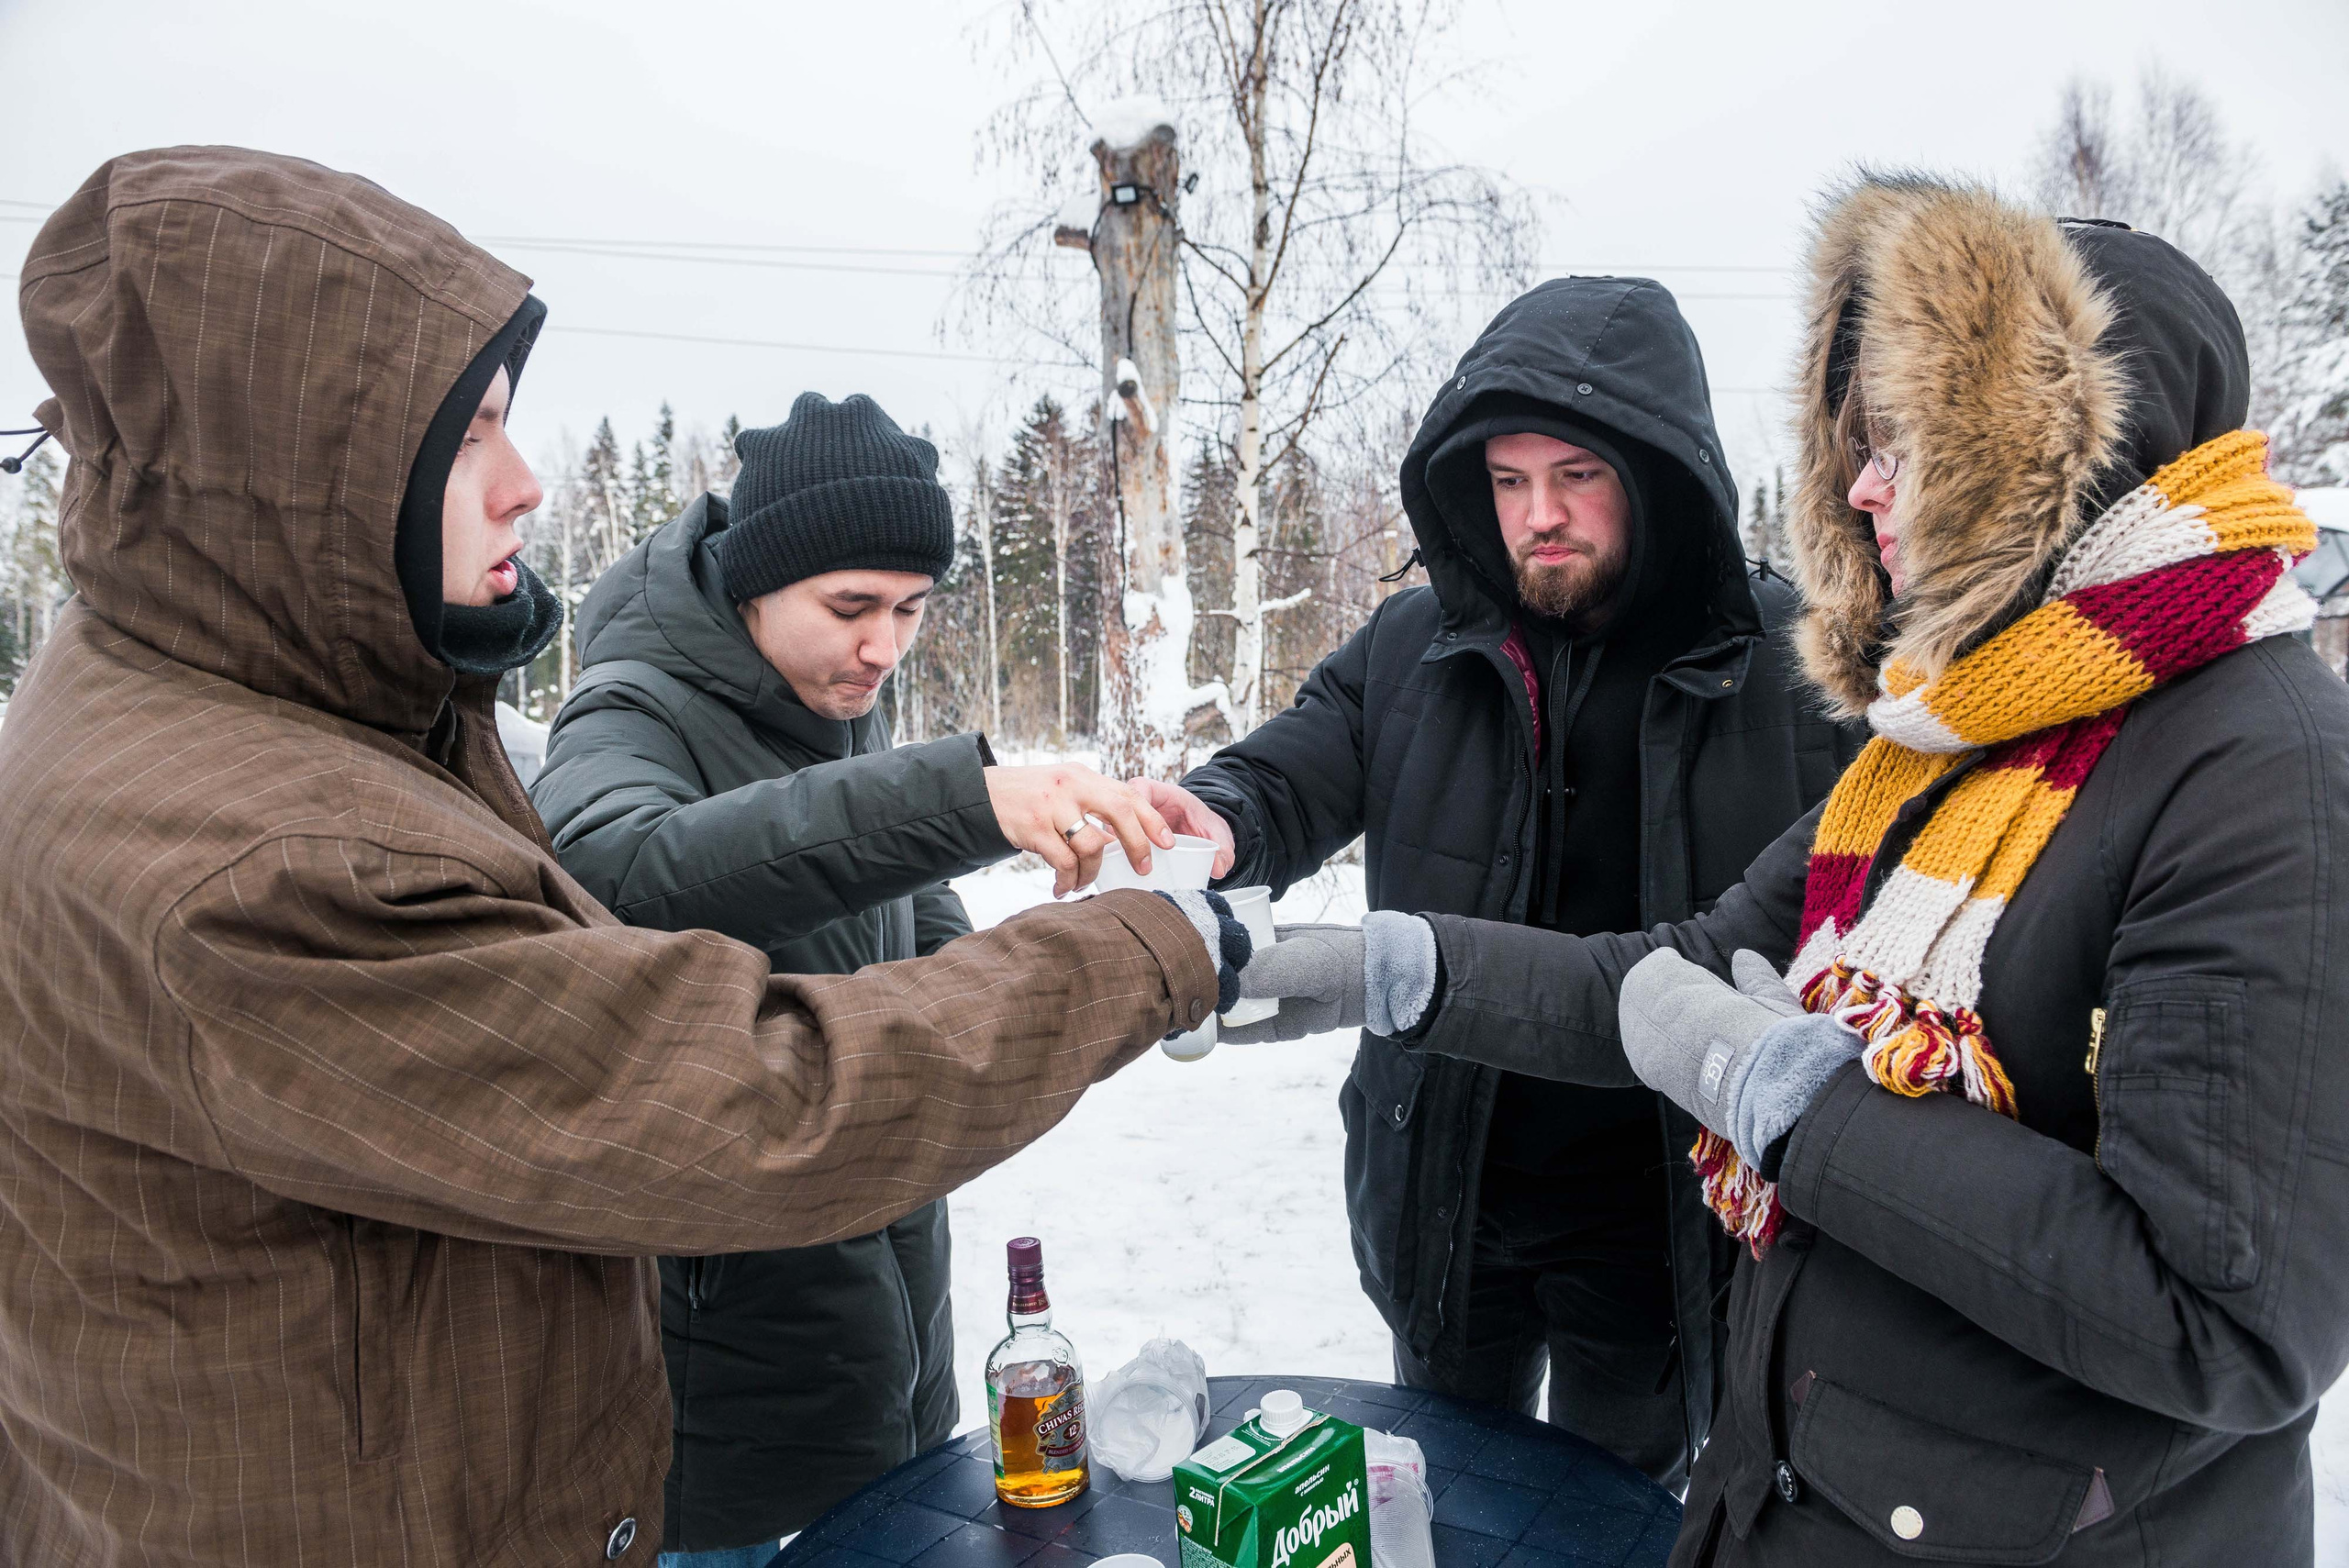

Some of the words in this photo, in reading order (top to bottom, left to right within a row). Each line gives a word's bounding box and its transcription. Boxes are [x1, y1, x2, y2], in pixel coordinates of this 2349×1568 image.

[1038, 1409, 1073, 1434] CHIVAS
[1068, 1424, 1077, 1438] 12
[1188, 1485, 1197, 1499] 2
[1295, 1464, 1330, 1495] апельсин
[1271, 1480, 1359, 1568] Добрый
